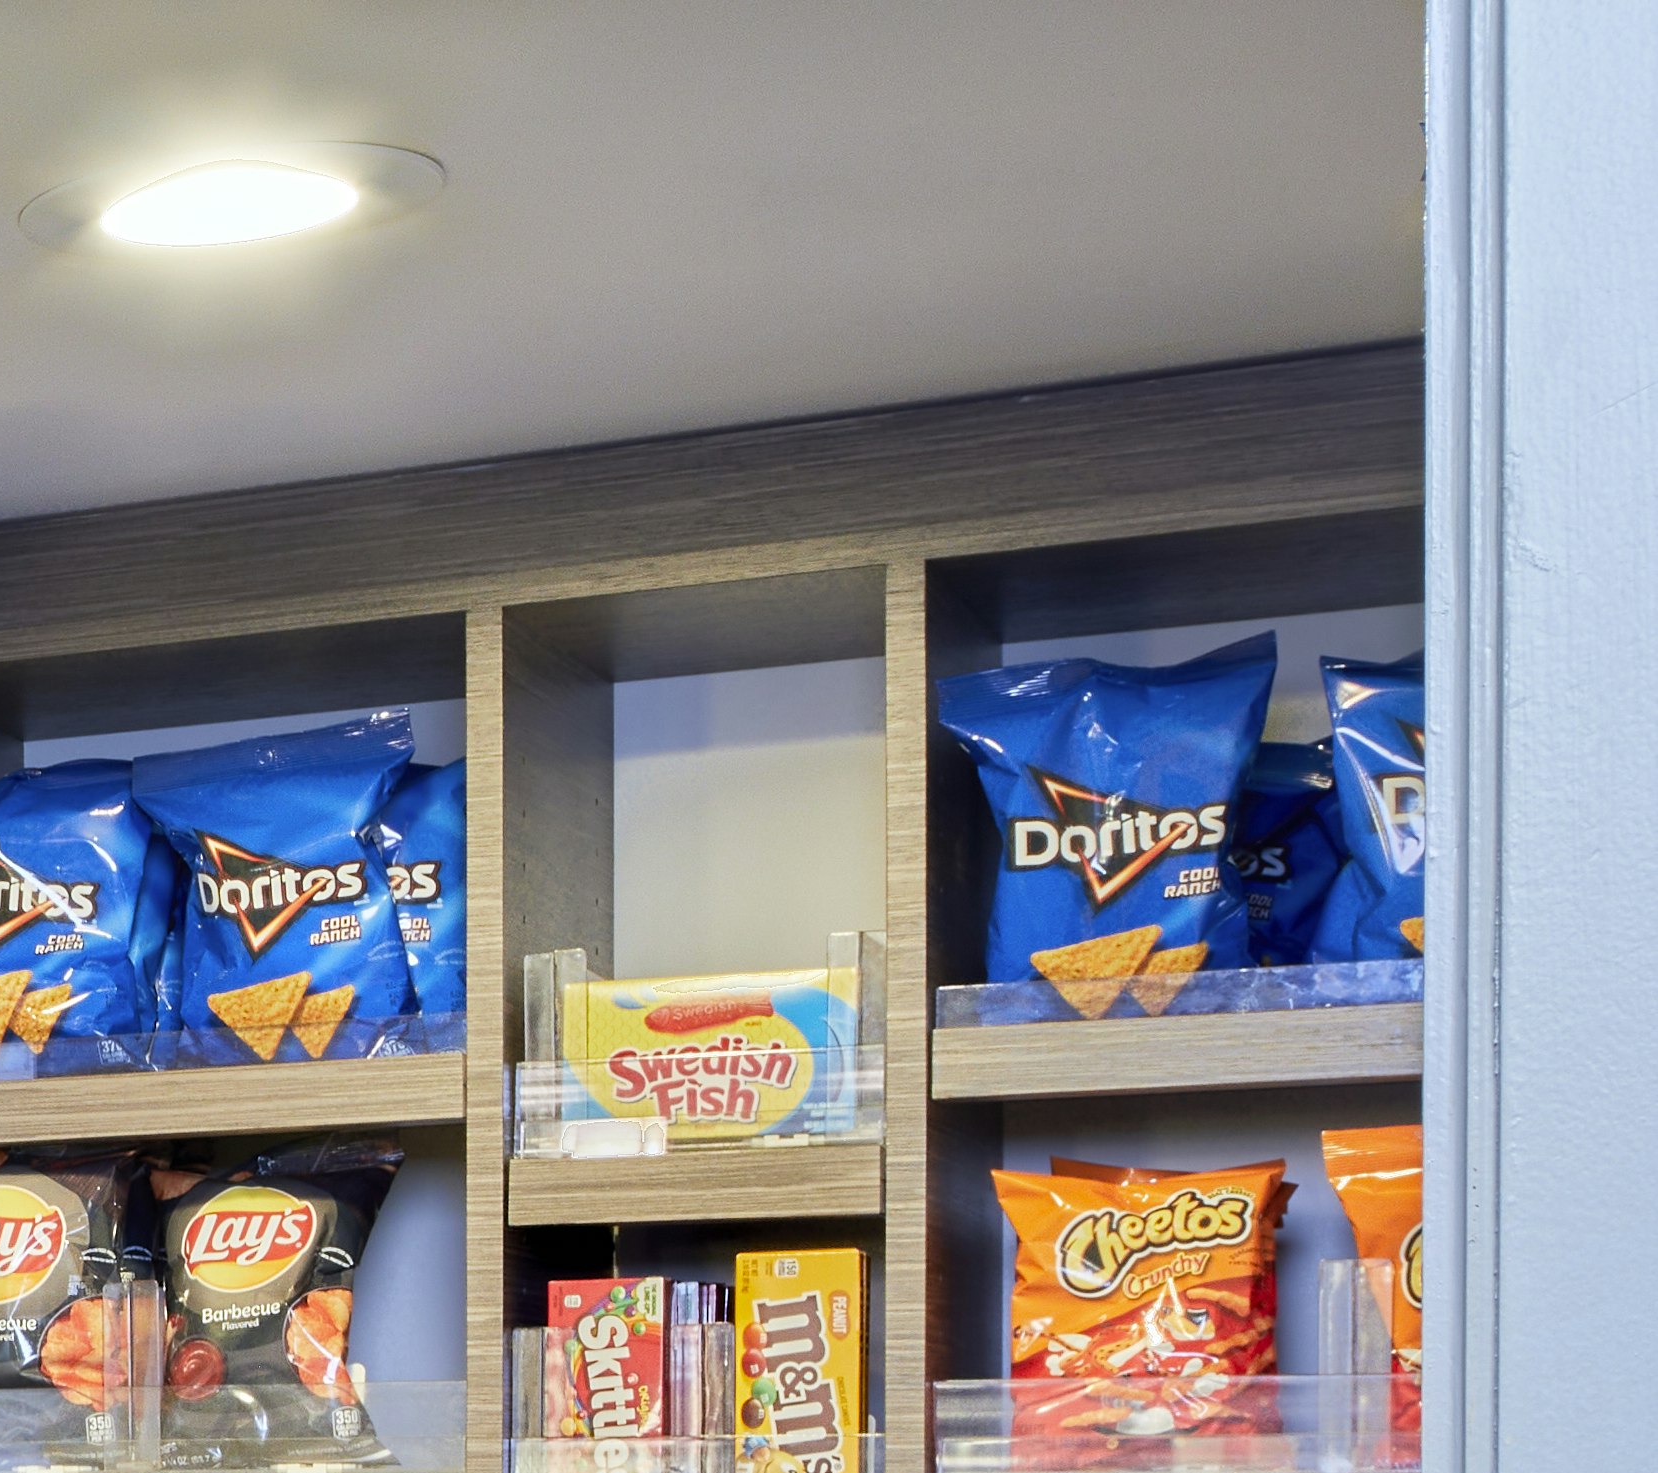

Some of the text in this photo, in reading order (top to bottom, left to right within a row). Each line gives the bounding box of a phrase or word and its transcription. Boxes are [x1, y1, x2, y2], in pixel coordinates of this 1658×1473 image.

[1013, 805, 1226, 868] Doritos
[197, 862, 366, 915] Doritos
[1164, 879, 1221, 898] RANCH
[309, 927, 361, 946] RANCH
[320, 915, 360, 932] COOL
[608, 1036, 795, 1099] Swedish
[649, 1078, 758, 1122] Fish
[187, 1206, 308, 1267] Lay's
[1060, 1191, 1248, 1293] Cheetos
[1123, 1252, 1210, 1299] Crunchy
[201, 1301, 281, 1324] Barbecue
[221, 1318, 260, 1331] Flavored
[833, 1295, 847, 1334] PEANUT
[334, 1407, 360, 1425] 350
